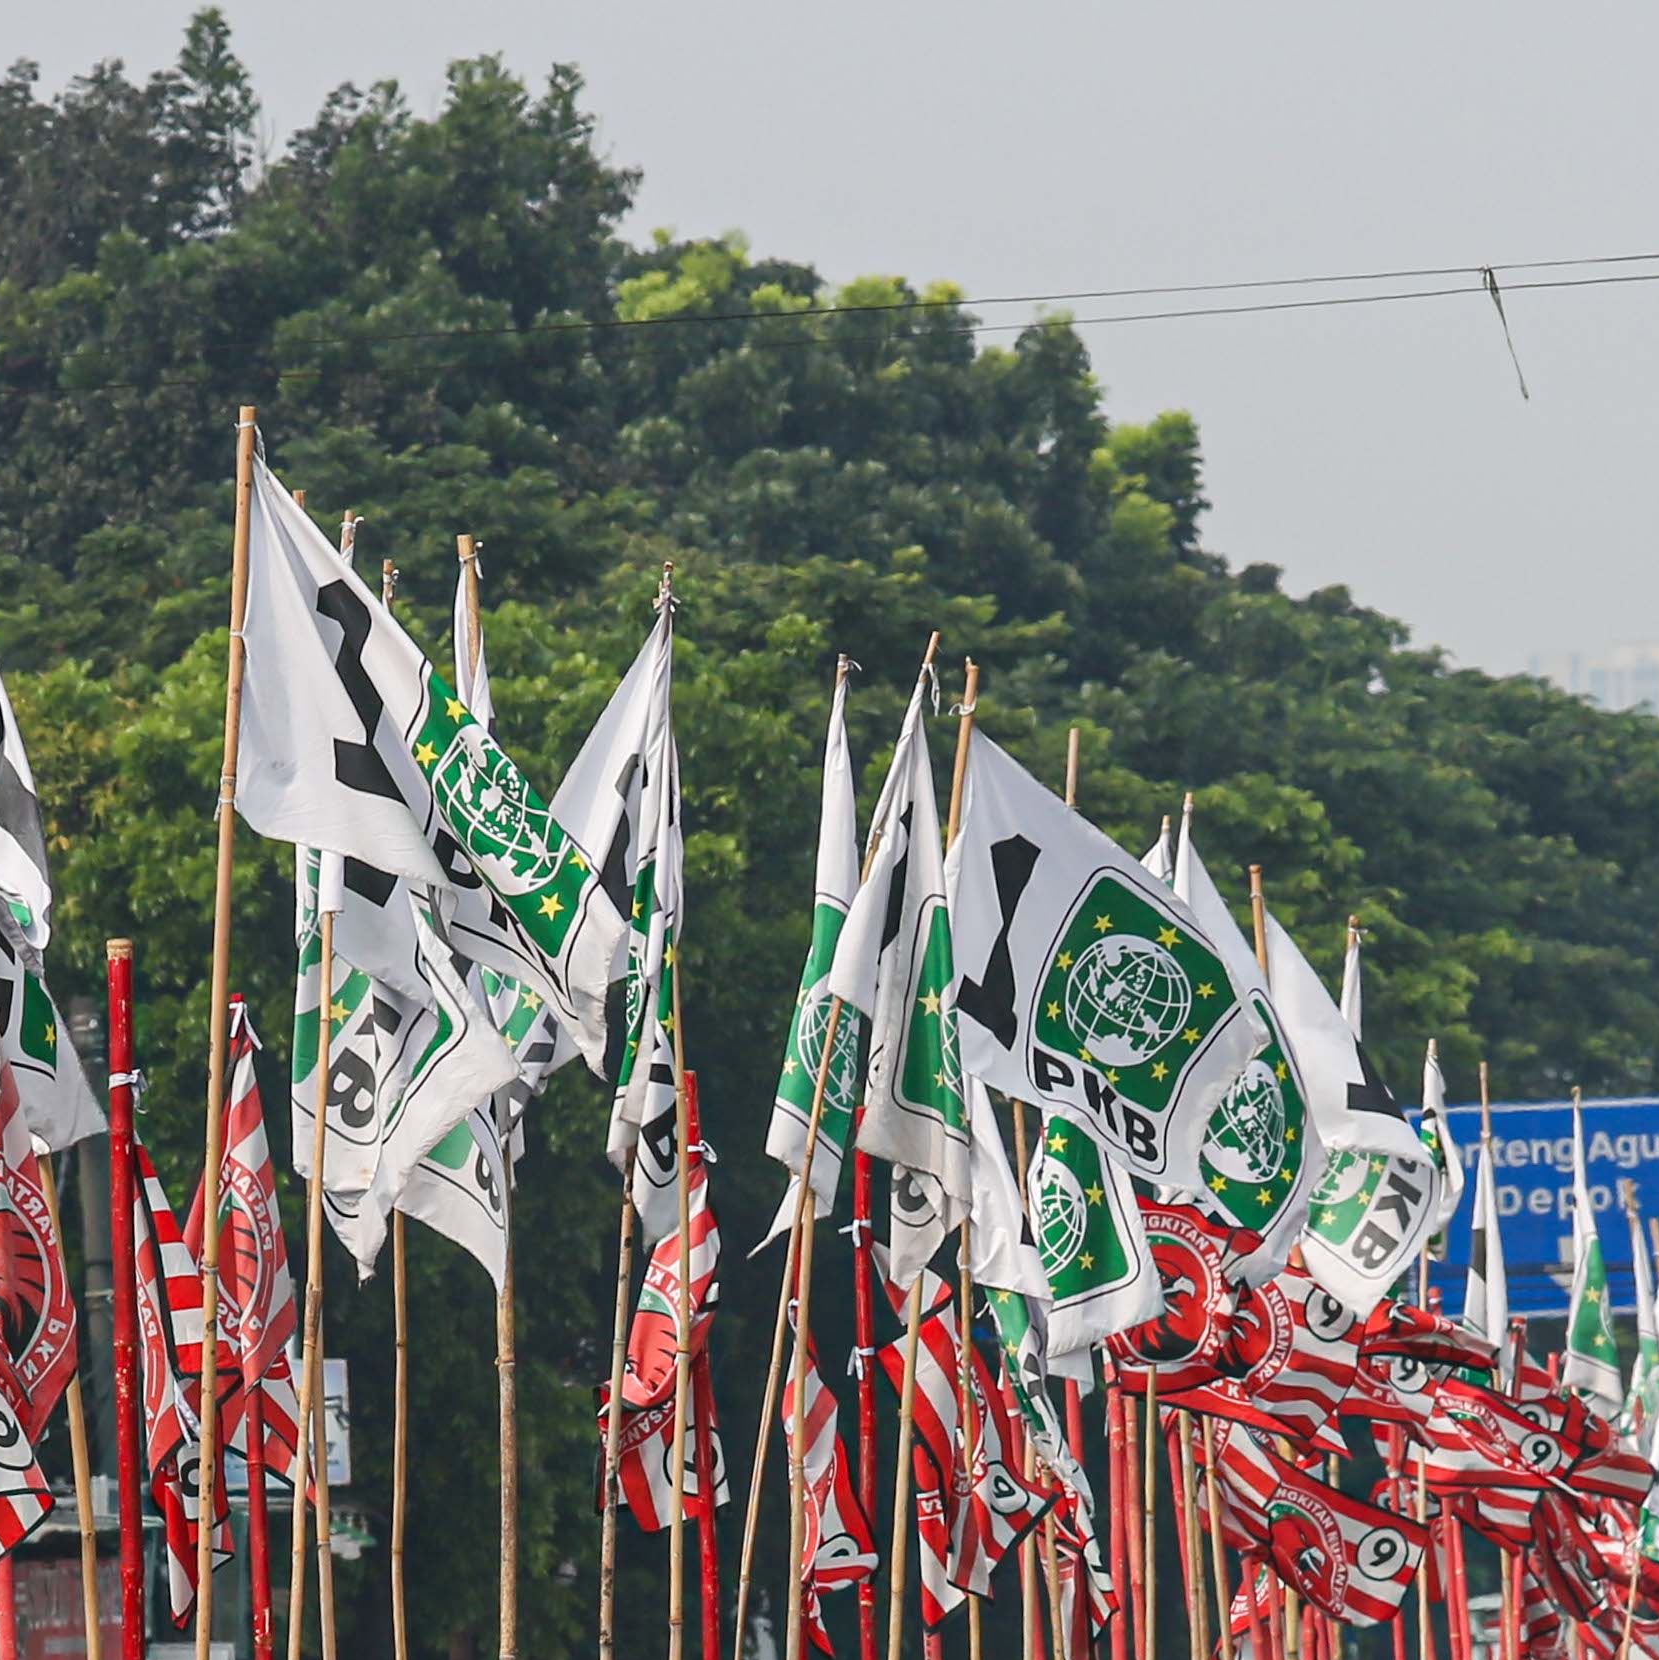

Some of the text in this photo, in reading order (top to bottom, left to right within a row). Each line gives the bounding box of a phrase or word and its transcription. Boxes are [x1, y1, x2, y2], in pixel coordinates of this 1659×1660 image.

[1031, 1045, 1160, 1164] PKB
[1532, 1440, 1552, 1465] 9
[1369, 1537, 1398, 1567] 9
